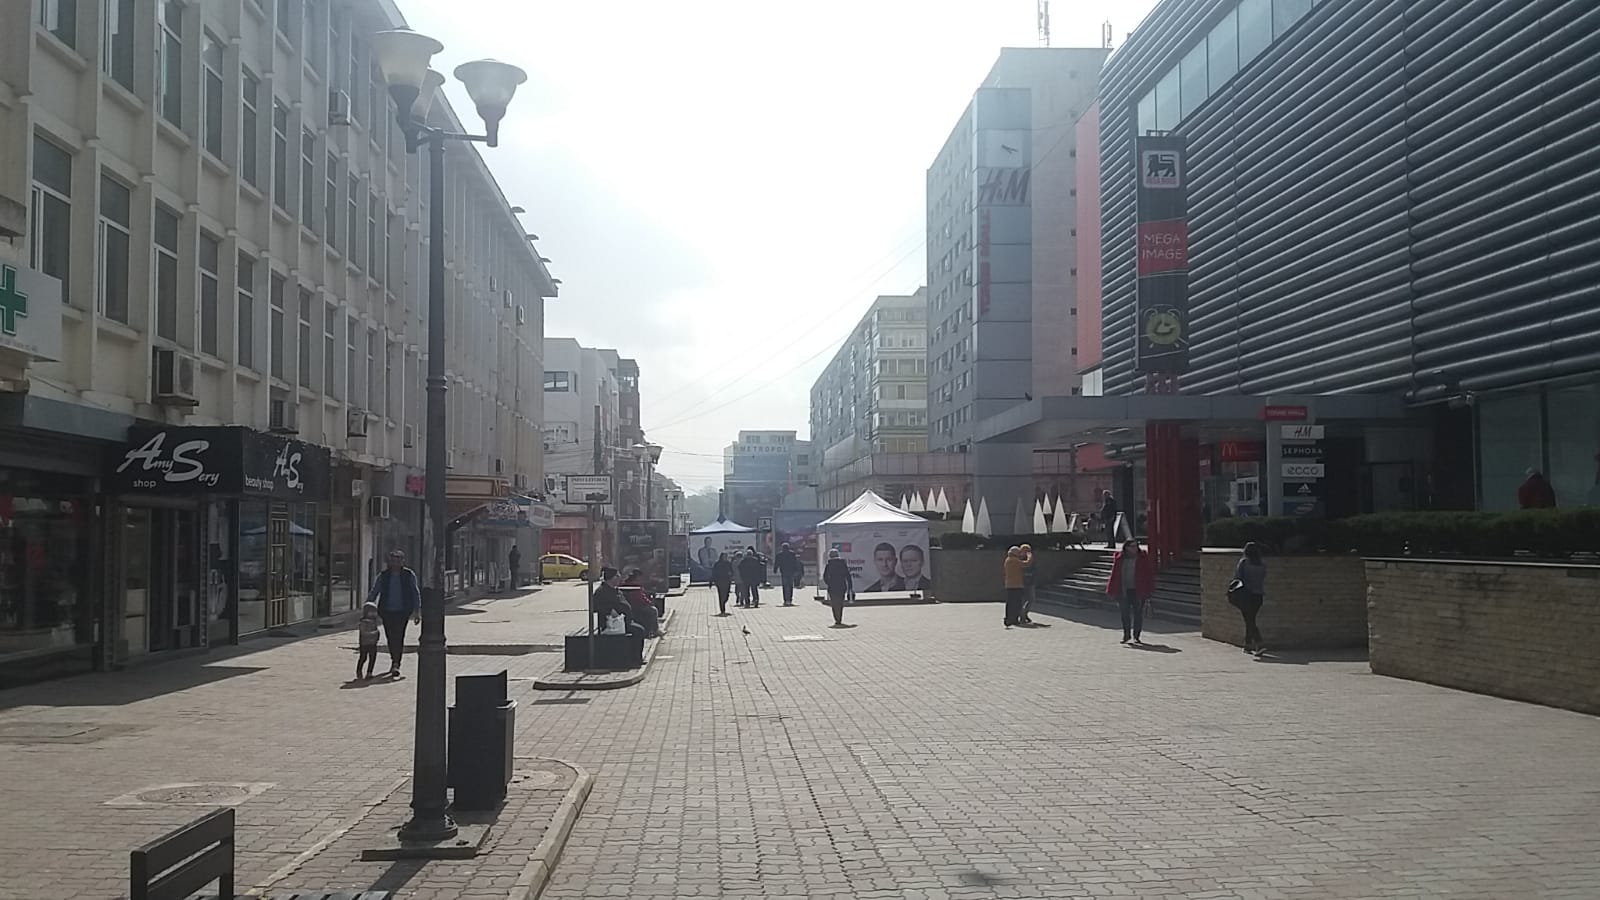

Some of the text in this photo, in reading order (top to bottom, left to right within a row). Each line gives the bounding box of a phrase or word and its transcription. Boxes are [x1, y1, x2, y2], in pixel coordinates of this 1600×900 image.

[978, 169, 1031, 203] H&M
[1143, 233, 1180, 245] MEGA
[1142, 249, 1183, 260] IMAGE
[1283, 447, 1322, 455] SEPHORA
[133, 480, 157, 488] shop
